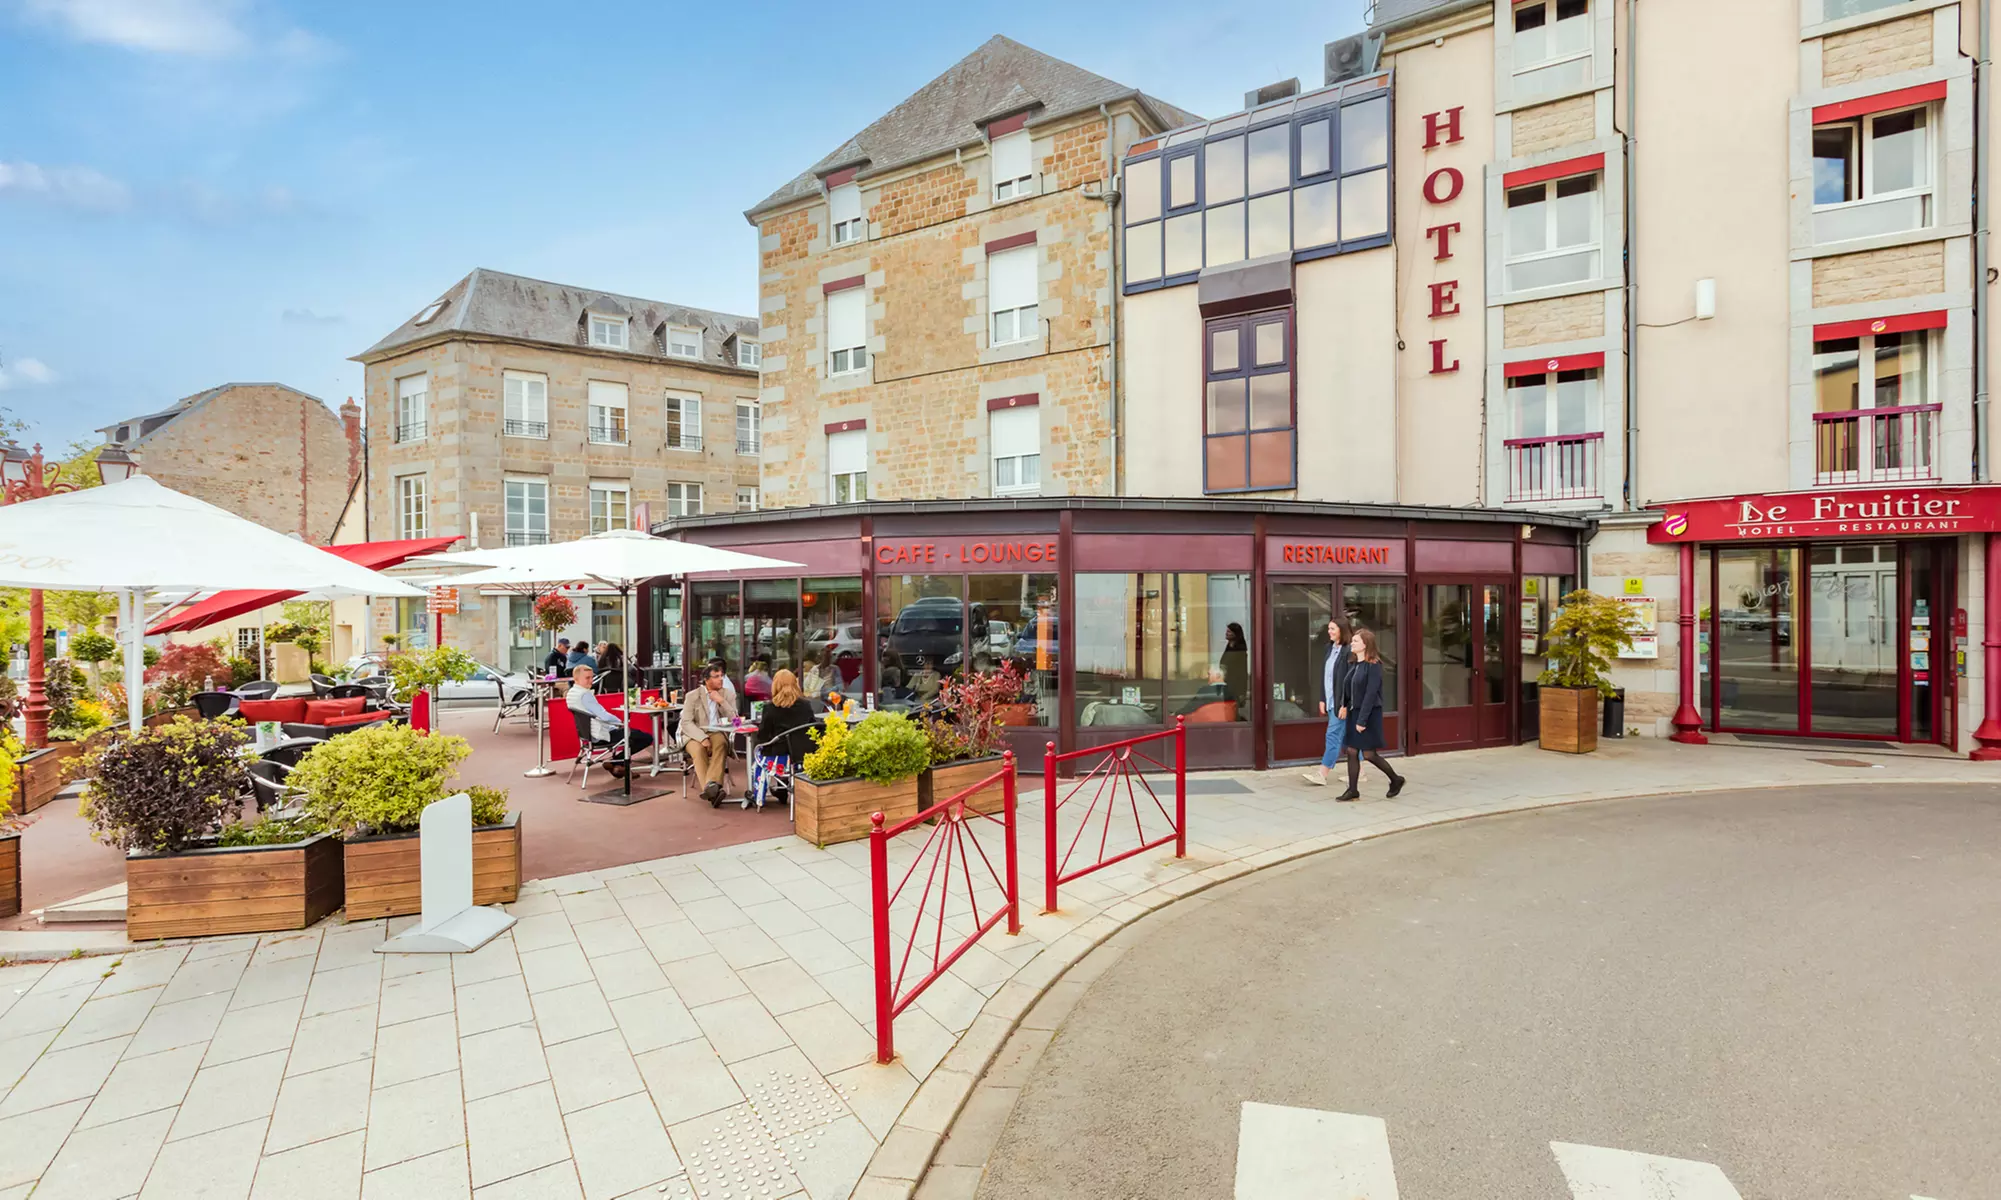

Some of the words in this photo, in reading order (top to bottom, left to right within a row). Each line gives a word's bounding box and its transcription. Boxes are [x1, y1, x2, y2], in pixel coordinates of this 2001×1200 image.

[1421, 105, 1464, 375] HOTEL
[1739, 501, 1787, 523] Le
[1811, 494, 1960, 519] Fruitier
[1739, 526, 1796, 536] HOTEL
[1839, 520, 1959, 532] RESTAURANT
[876, 545, 936, 564] CAFE
[960, 543, 1057, 563] LOUNGE
[1283, 544, 1390, 564] RESTAURANT
